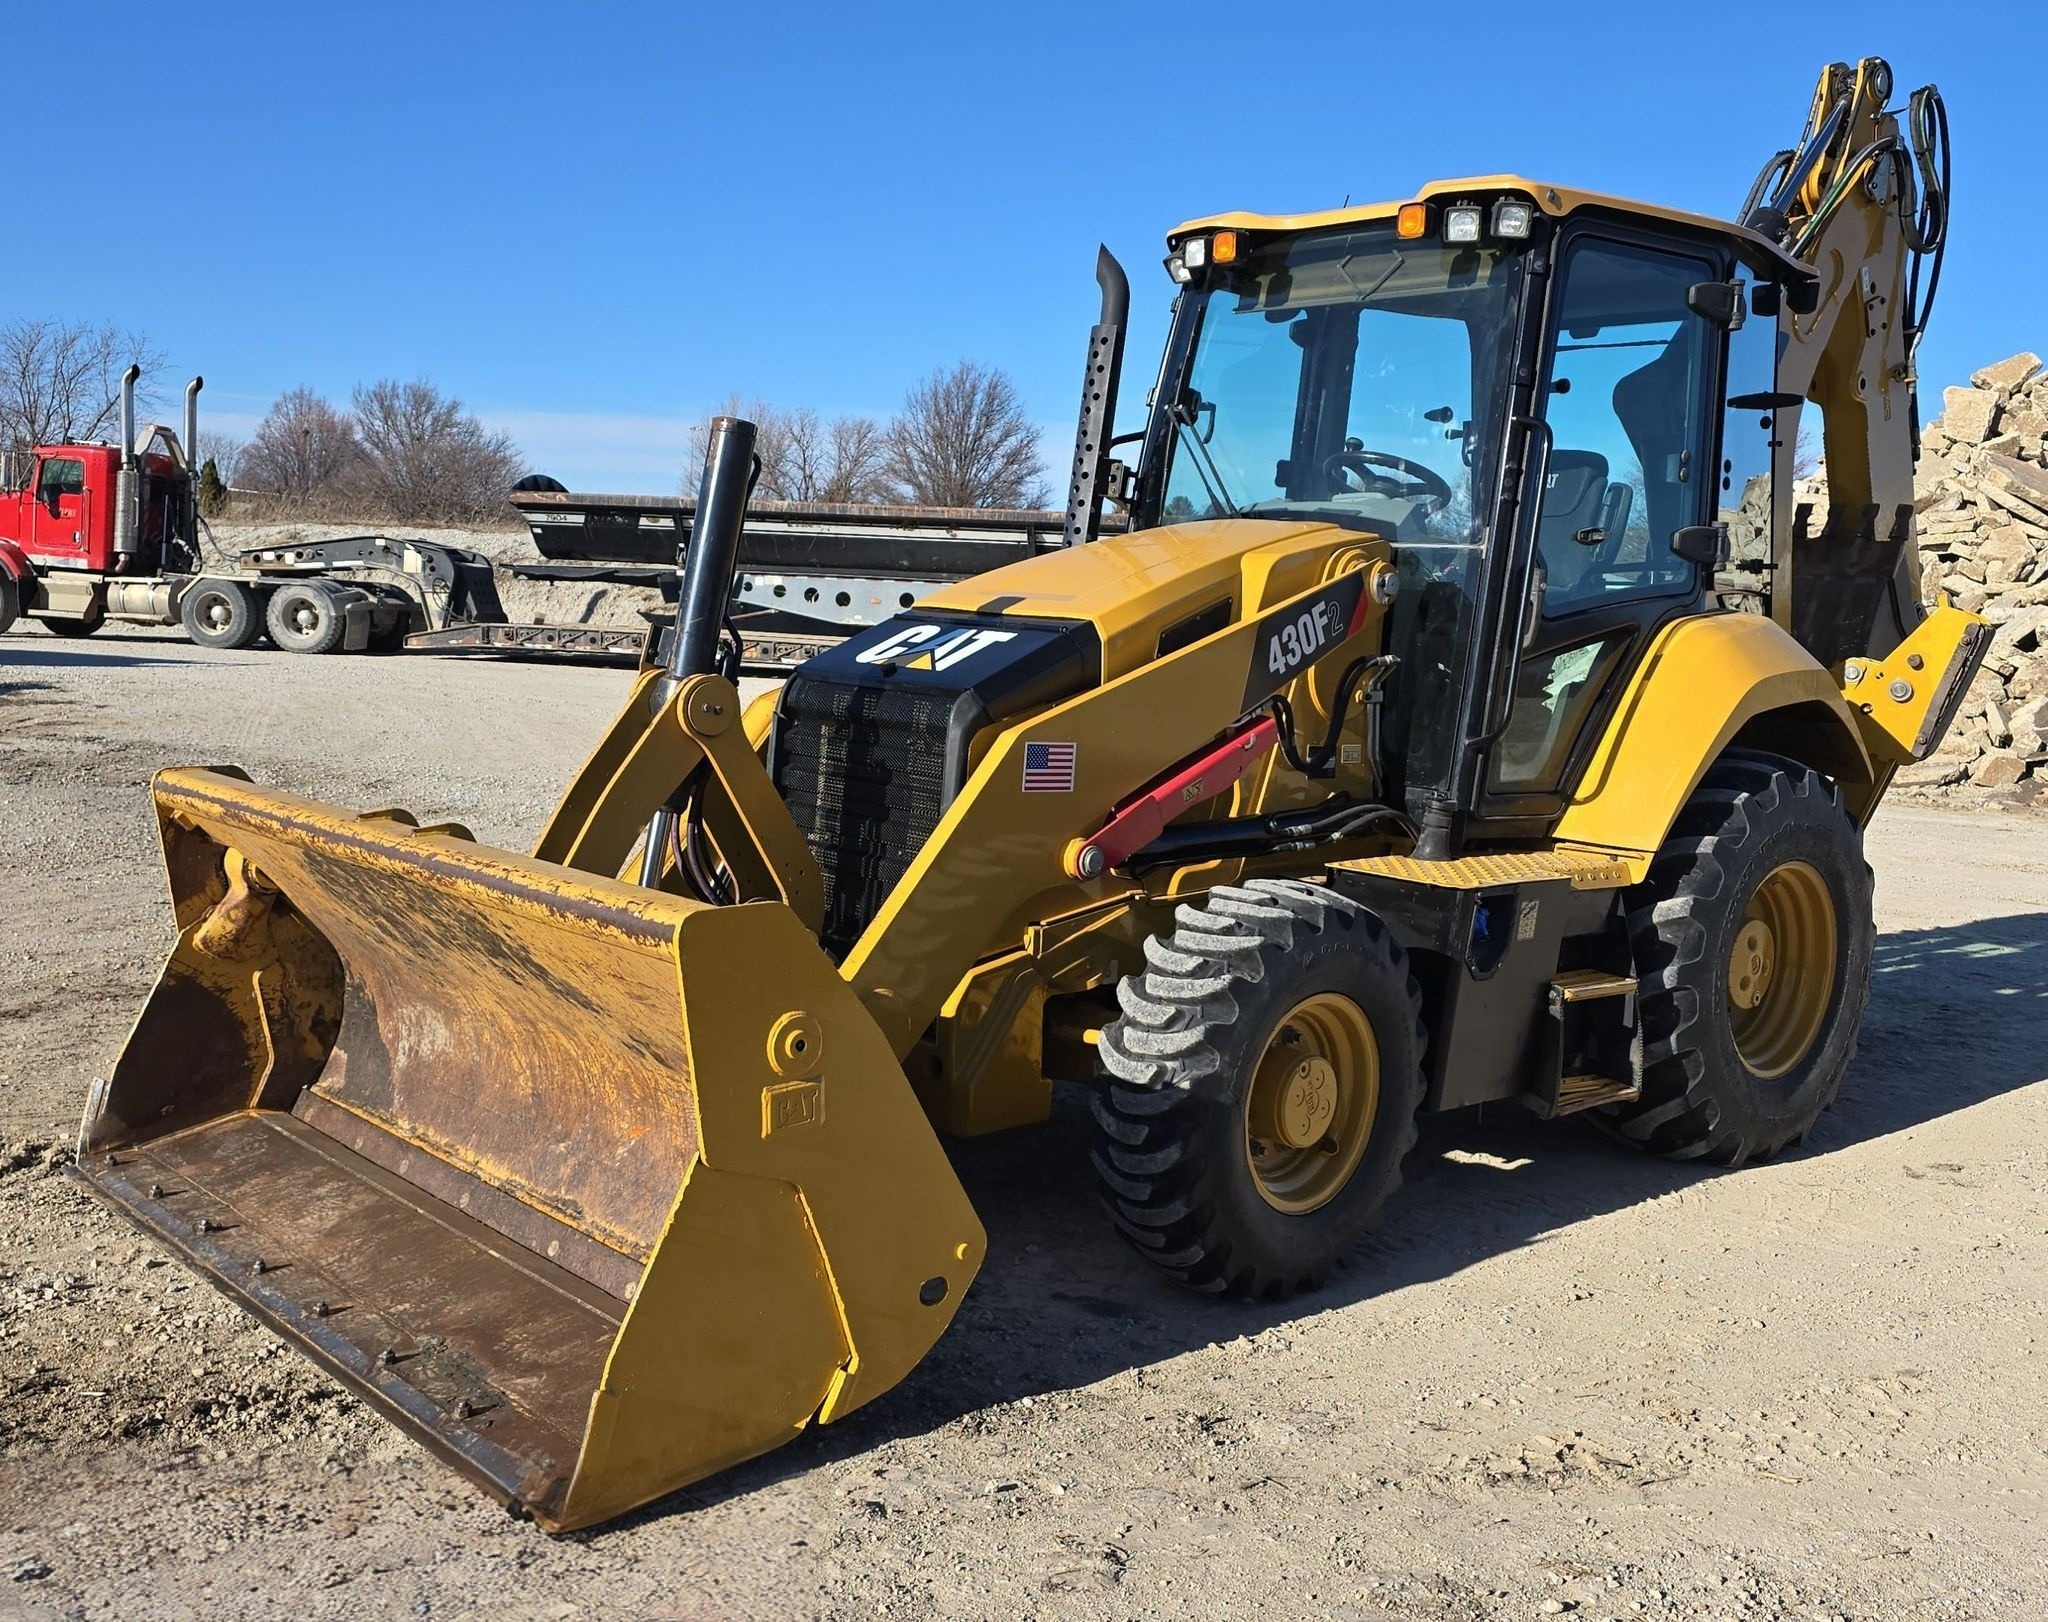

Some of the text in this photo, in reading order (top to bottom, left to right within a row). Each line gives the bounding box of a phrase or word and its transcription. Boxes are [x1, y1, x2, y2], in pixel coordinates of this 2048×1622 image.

[855, 625, 1018, 671] CAT
[1269, 601, 1343, 674] 430F2
[778, 1089, 818, 1128] CAT
